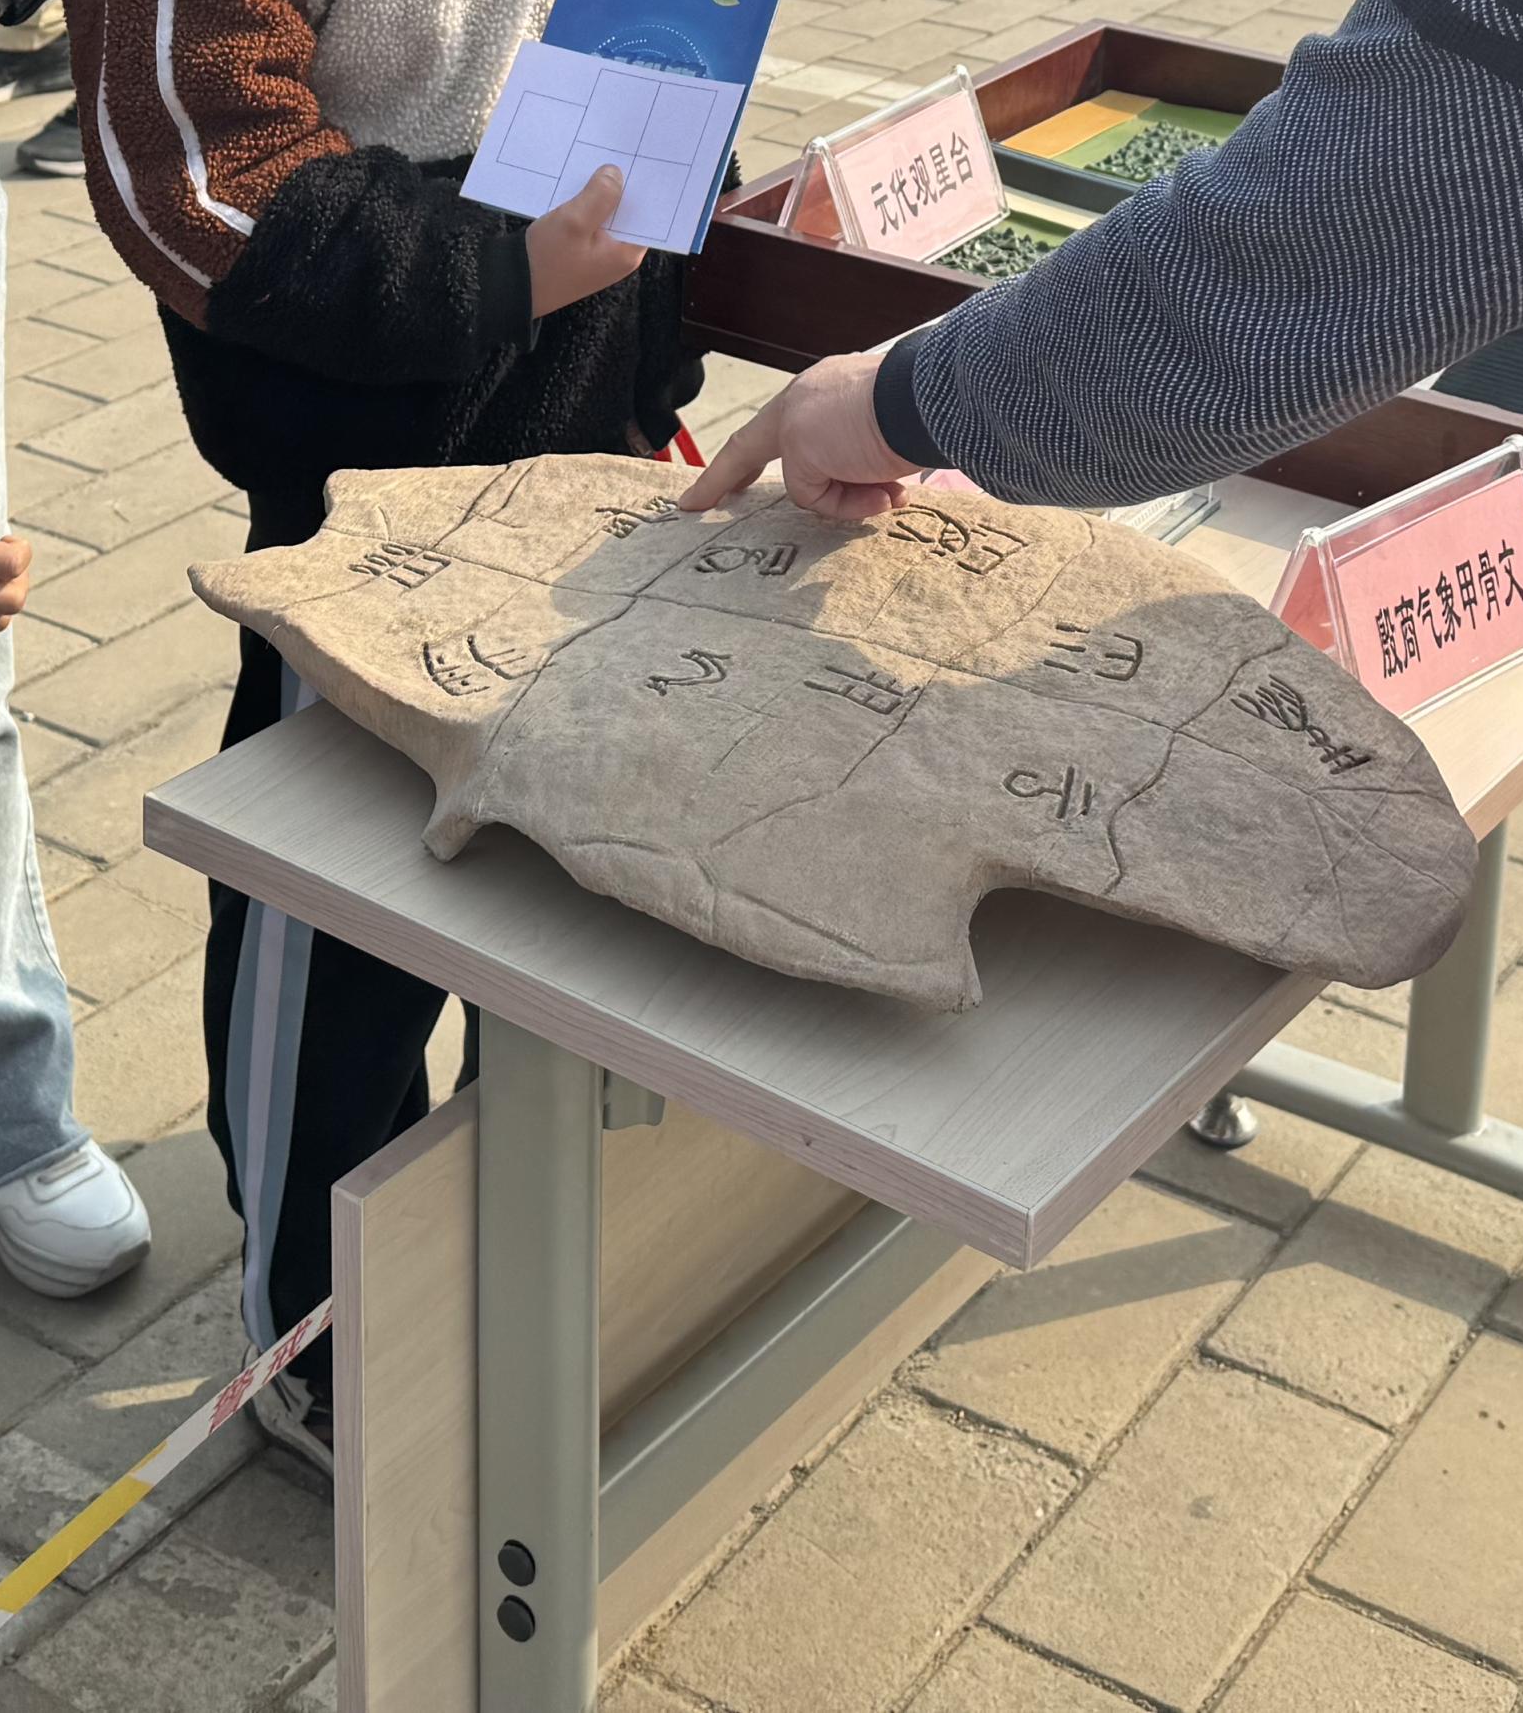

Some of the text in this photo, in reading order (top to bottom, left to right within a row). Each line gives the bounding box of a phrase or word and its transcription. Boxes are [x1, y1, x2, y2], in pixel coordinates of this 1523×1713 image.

[871, 131, 974, 236] 元代观星台
